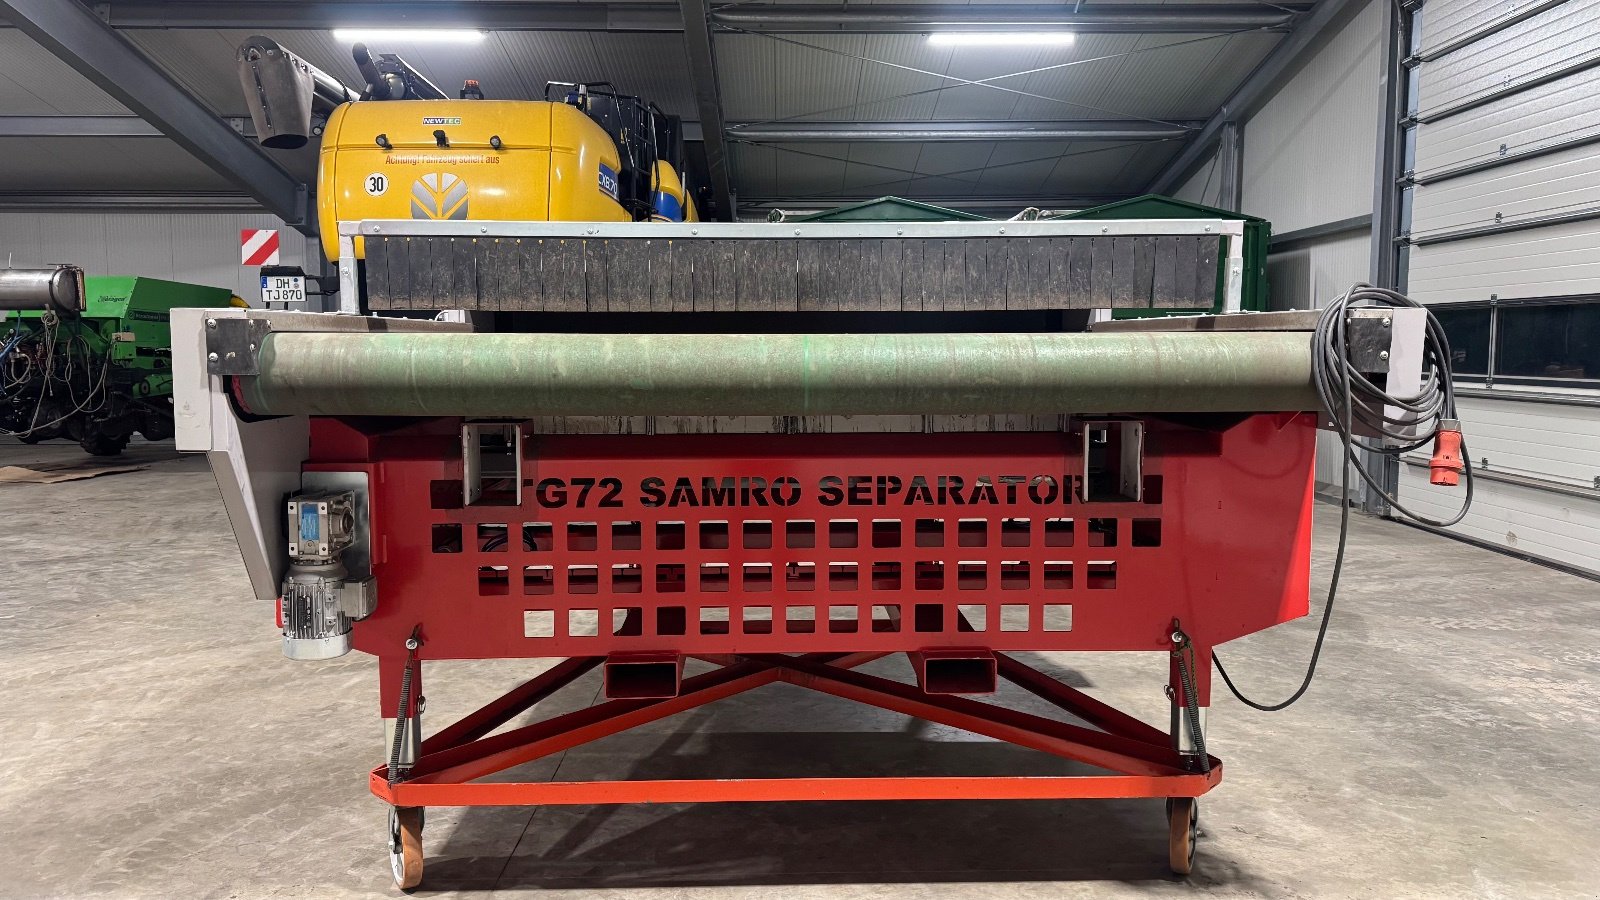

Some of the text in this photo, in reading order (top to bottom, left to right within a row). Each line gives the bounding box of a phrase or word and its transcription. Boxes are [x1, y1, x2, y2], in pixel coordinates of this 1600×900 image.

[386, 155, 420, 165] Achtung!
[485, 156, 500, 164] aus
[369, 177, 384, 192] 30
[276, 278, 290, 289] DH
[266, 290, 302, 300] TJ 870
[639, 476, 802, 508] SAMRO
[817, 474, 1085, 506] SEPARATOR
